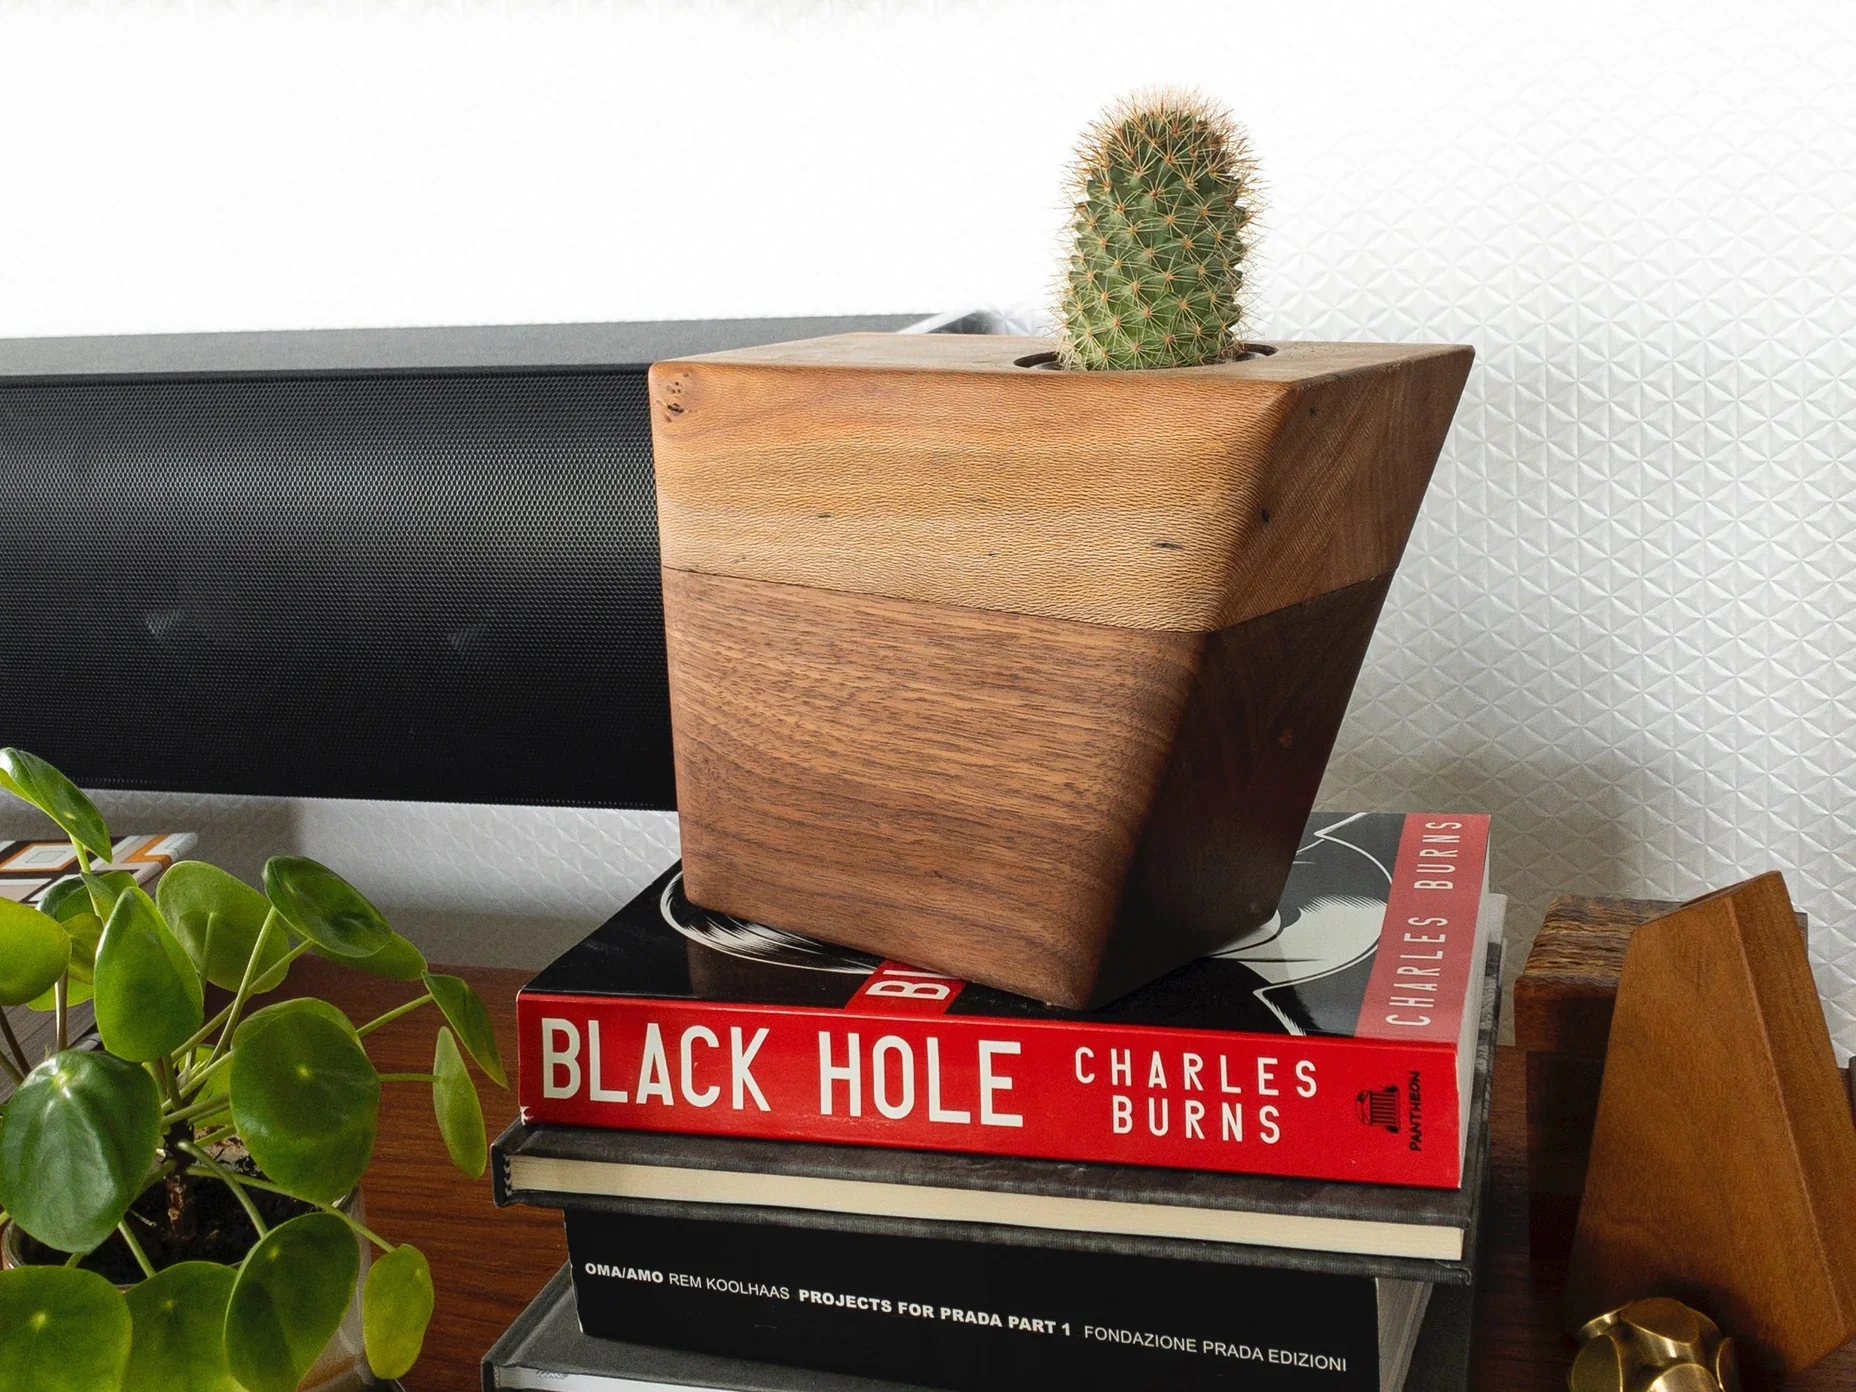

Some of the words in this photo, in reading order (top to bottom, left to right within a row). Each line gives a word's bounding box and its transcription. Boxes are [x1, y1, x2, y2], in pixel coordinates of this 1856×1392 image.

[1413, 822, 1462, 890] BURNS
[1385, 916, 1449, 1026] CHARLES
[541, 1017, 771, 1111] BLACK
[818, 1031, 1023, 1127] HOLE
[1075, 1046, 1318, 1098] CHARLES
[1408, 1070, 1421, 1152] PANTHEON
[1112, 1095, 1281, 1144] BURNS
[585, 1262, 664, 1284] OMA/AMO
[669, 1273, 702, 1289] REM
[706, 1278, 790, 1300] KOOLHAAS
[799, 1288, 892, 1313] PROJECTS
[898, 1302, 935, 1318] FOR
[940, 1308, 1002, 1327] PRADA
[1008, 1315, 1056, 1334] PART
[1061, 1322, 1071, 1336] 1
[1084, 1326, 1198, 1353] FONDAZIONE
[1203, 1340, 1264, 1361] PRADA
[1268, 1349, 1347, 1372] EDIZIONI
